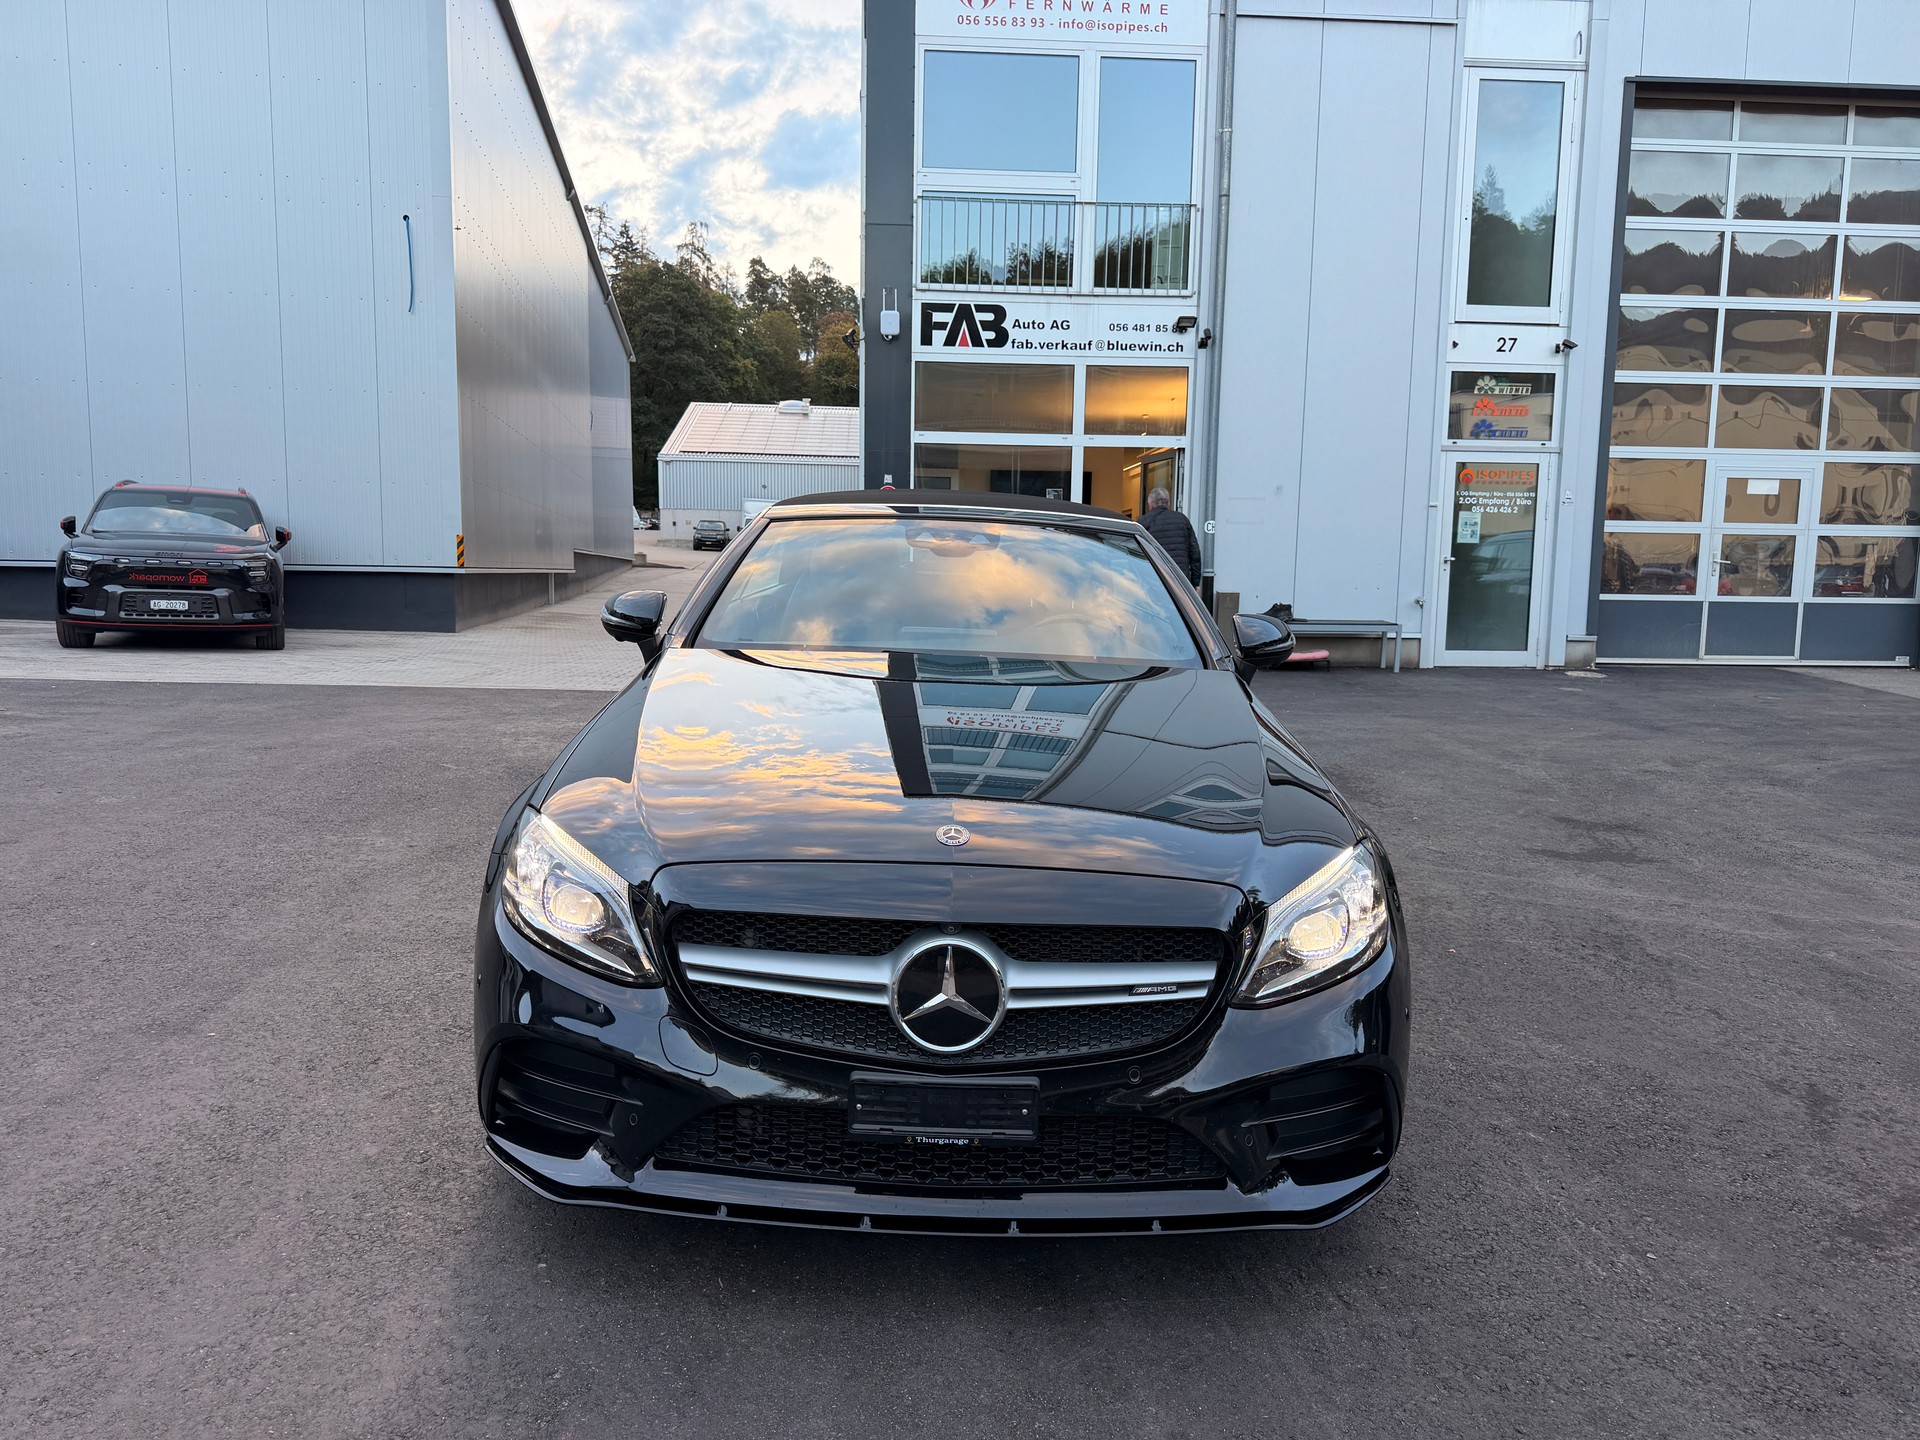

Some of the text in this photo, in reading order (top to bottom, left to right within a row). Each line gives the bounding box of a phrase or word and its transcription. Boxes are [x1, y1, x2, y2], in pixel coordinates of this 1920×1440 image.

[1009, 0, 1168, 15] FERNWÄRME
[957, 14, 980, 25] 056
[984, 16, 1007, 26] 556
[1011, 17, 1026, 27] 83
[1030, 17, 1045, 28] 93
[1058, 18, 1168, 34] info@isopipes.ch
[920, 302, 1009, 348] FAB
[1012, 318, 1071, 331] Auto AG
[1109, 322, 1128, 332] 056
[1132, 323, 1151, 333] 481
[1155, 324, 1168, 333] 85
[1011, 339, 1184, 353] fab.verkauf@bluewin.ch
[1496, 337, 1518, 352] 27
[1477, 470, 1535, 480] ISOPIPES
[1479, 498, 1510, 506] Empfang
[165, 601, 187, 609] 20278
[1148, 985, 1177, 993] AMG
[915, 1136, 969, 1145] Thurgarage
